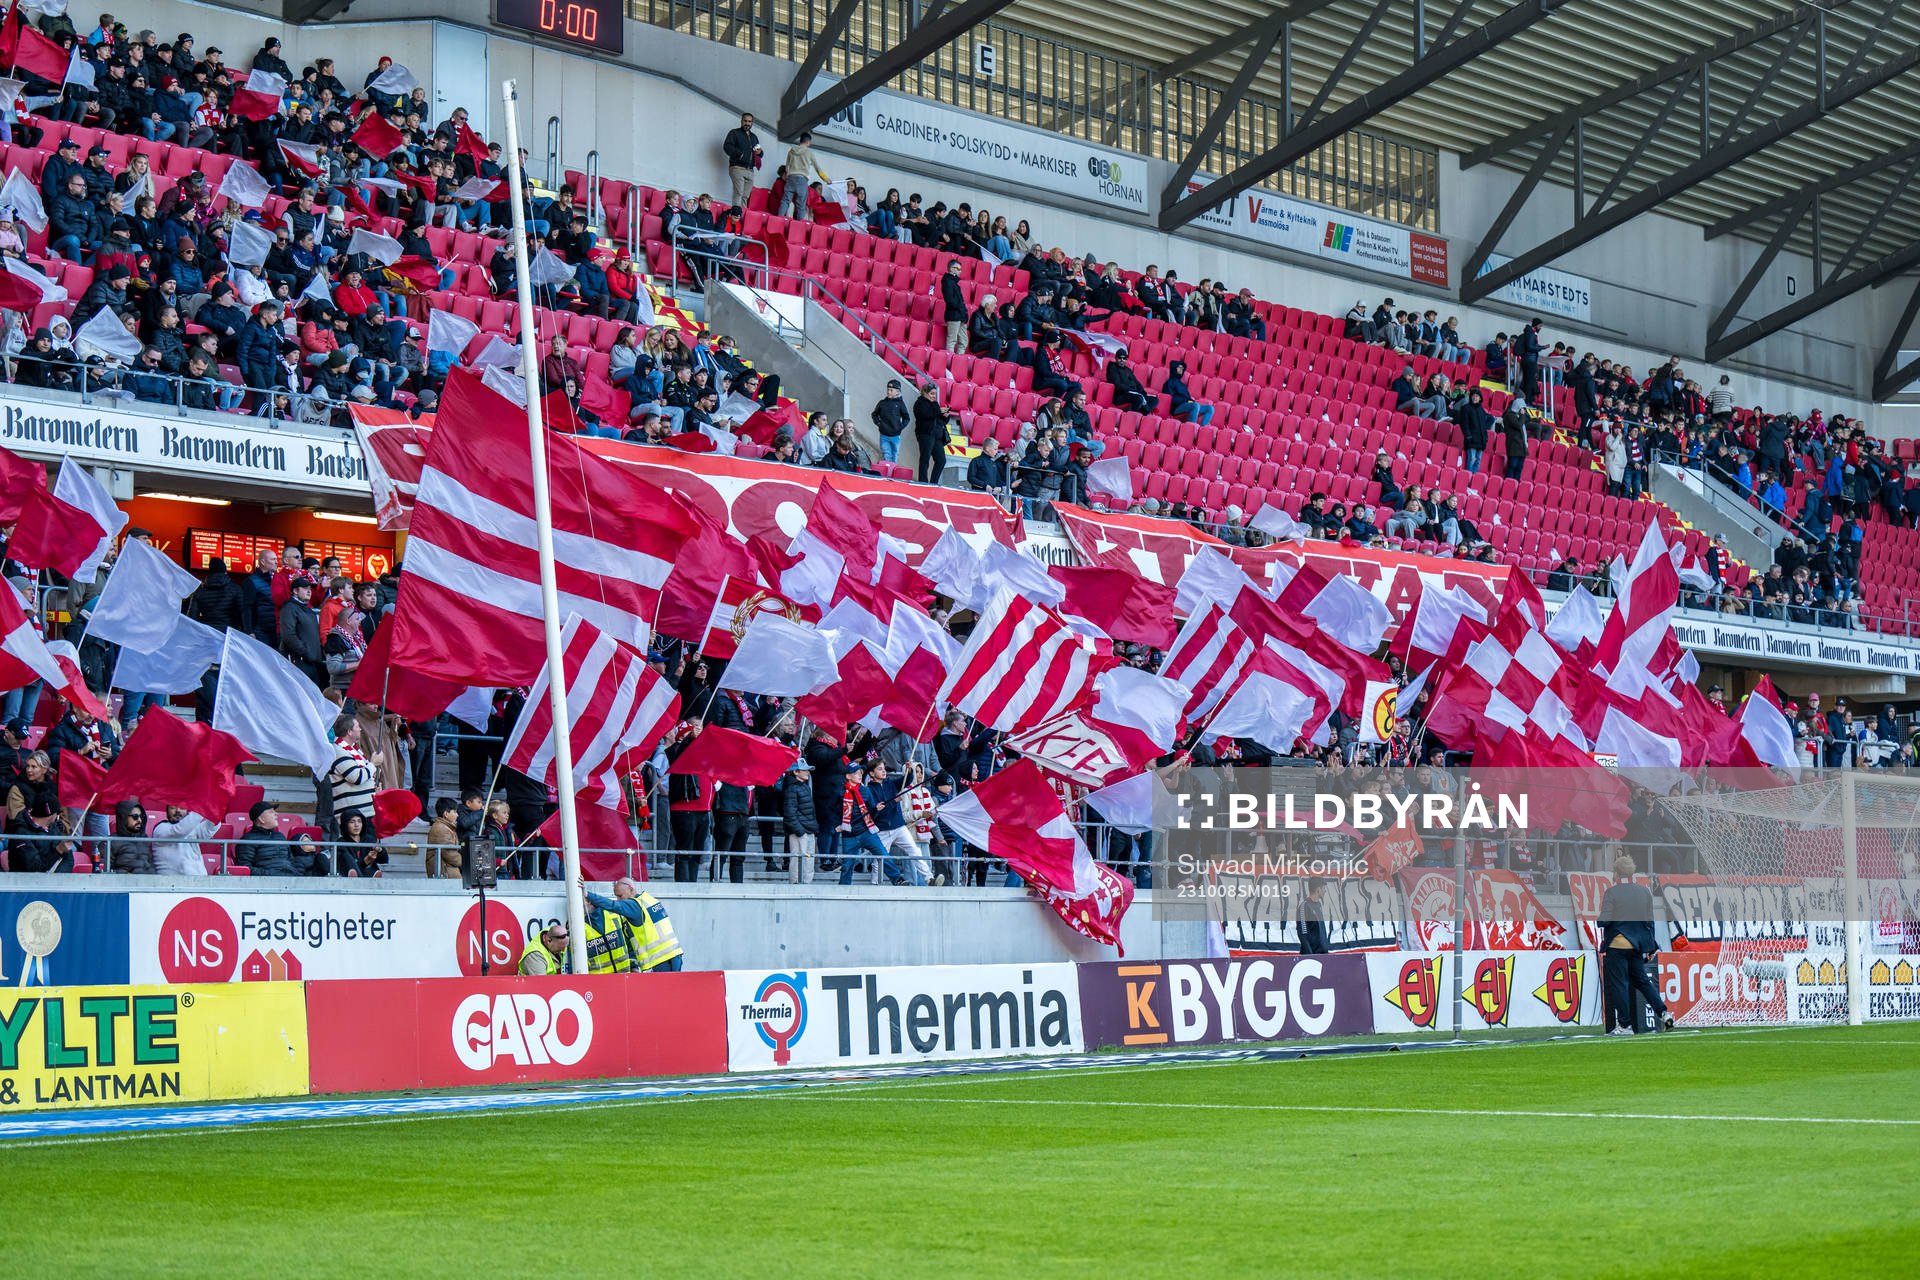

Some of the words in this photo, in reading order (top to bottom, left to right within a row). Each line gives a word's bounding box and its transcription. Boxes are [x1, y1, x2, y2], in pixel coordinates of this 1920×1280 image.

[540, 0, 598, 41] 0:00
[981, 45, 992, 73] E
[876, 113, 940, 144] GARDINER
[950, 131, 1011, 161] SOLSKYDD
[1020, 151, 1078, 178] MARKISER
[1088, 156, 1122, 184] HEM
[1099, 178, 1142, 204] HÖRNAN
[1279, 209, 1286, 219] &
[1287, 211, 1317, 227] Kylteknik
[1378, 245, 1391, 253] Kabel
[1392, 247, 1398, 255] TV
[1787, 275, 1796, 296] D
[3, 405, 139, 453] Barometern
[160, 425, 286, 472] Barometern
[1713, 627, 1761, 652] Barometern
[1767, 634, 1811, 658] Barometern
[1818, 640, 1861, 664] Barometern
[1867, 647, 1909, 670] Barometern
[1412, 877, 1439, 912] KALMAR
[1663, 885, 1784, 940] SEKTION
[174, 929, 224, 968] NS
[241, 911, 397, 948] Fastigheter
[469, 929, 511, 966] NS
[740, 1003, 792, 1020] Thermia
[822, 970, 1071, 1057] Thermia
[1126, 981, 1160, 1028] K
[1168, 959, 1336, 1042] BYGG
[452, 989, 593, 1071] GARO
[0, 1077, 20, 1105] &
[35, 1072, 181, 1103] LANTMAN
